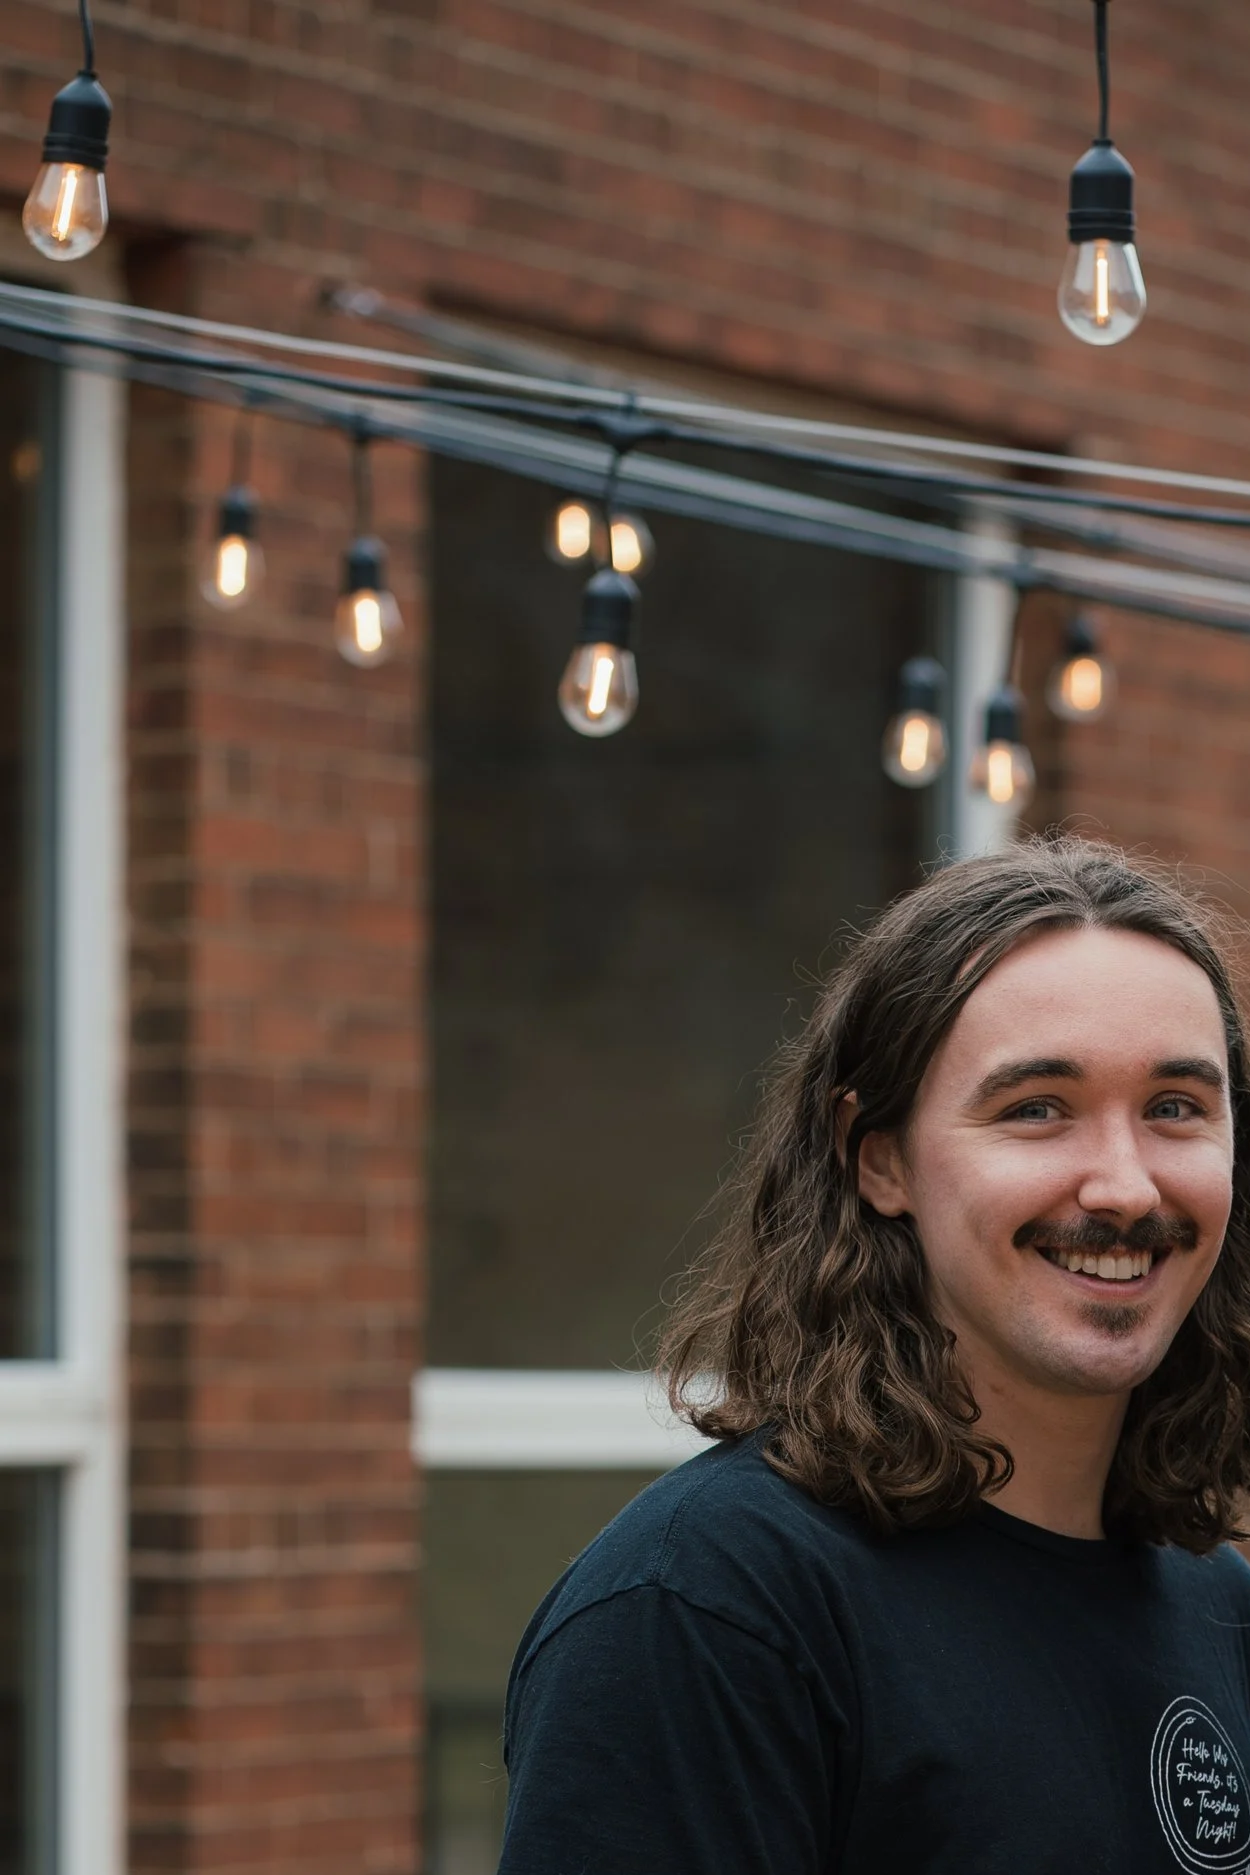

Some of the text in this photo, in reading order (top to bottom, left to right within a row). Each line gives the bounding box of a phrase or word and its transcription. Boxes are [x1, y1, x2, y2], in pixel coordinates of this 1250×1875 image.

[1181, 1737, 1210, 1764] Hello
[1183, 1790, 1241, 1818] a Tuesday
[1196, 1816, 1237, 1844] Night!
